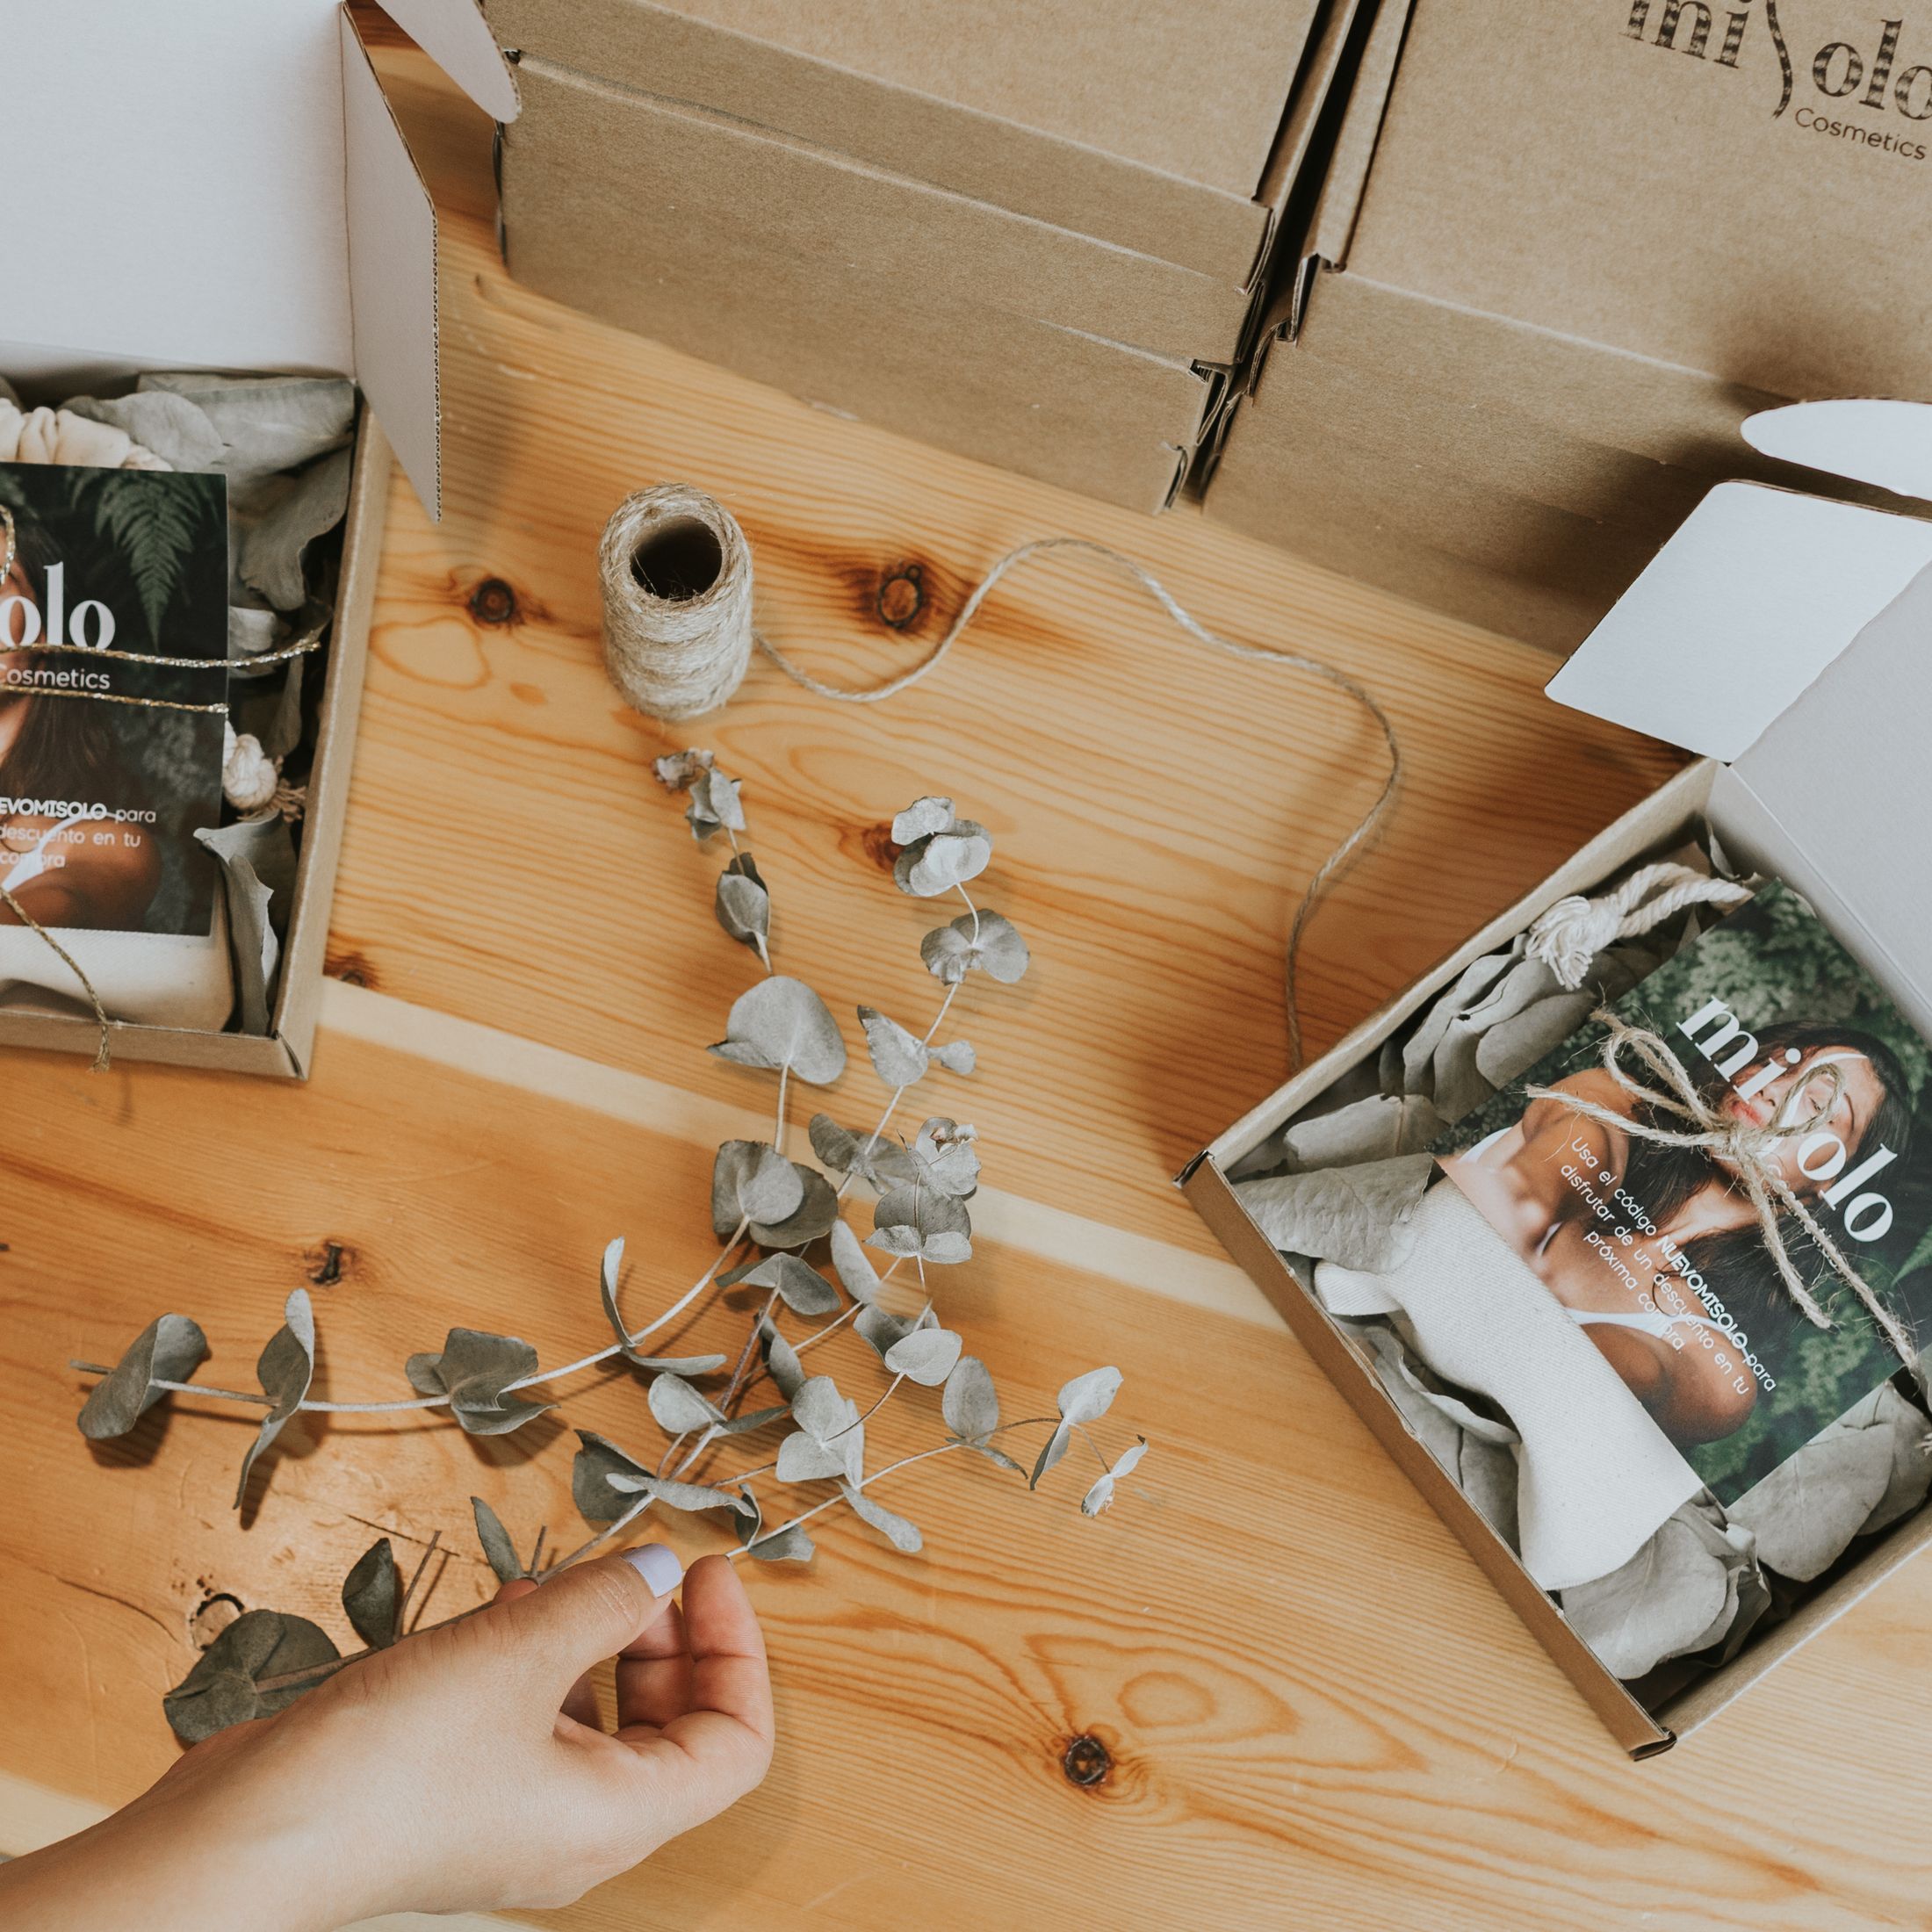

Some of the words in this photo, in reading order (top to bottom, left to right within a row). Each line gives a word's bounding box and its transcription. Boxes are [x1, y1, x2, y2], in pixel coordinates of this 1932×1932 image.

[1795, 107, 1926, 160] Cosmetics
[0, 663, 111, 689] osmetics
[93, 832, 115, 846] en
[124, 833, 141, 847] tu
[115, 808, 156, 825] para
[1561, 1164, 1615, 1222] disfrutar
[1614, 1224, 1633, 1247] de
[1633, 1248, 1653, 1271] un
[1654, 1272, 1714, 1350] descuento
[1714, 1352, 1734, 1375] en
[1734, 1374, 1749, 1395] tu
[1570, 1136, 1599, 1169] Usa
[1598, 1171, 1618, 1186] el
[1613, 1187, 1657, 1236] código
[1655, 1235, 1748, 1350] NUEVOMISOLO
[1741, 1352, 1777, 1392] para
[1583, 1229, 1638, 1290] próxima
